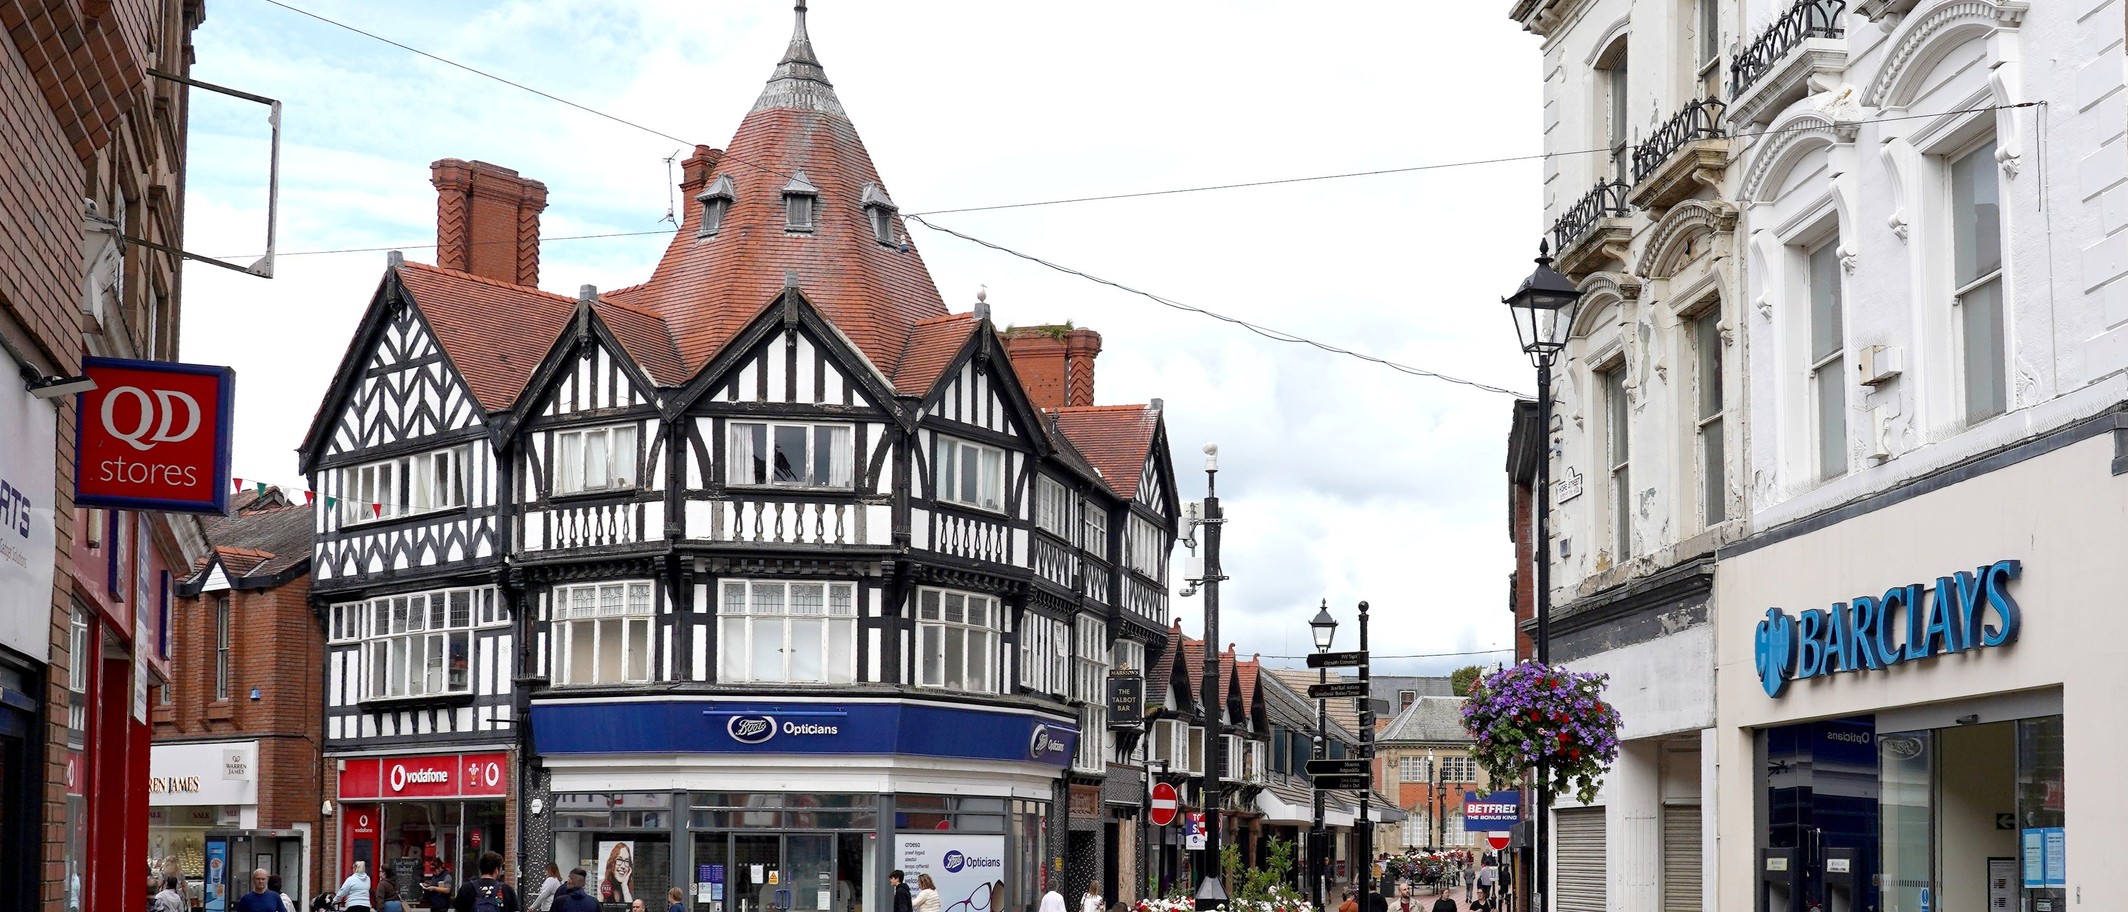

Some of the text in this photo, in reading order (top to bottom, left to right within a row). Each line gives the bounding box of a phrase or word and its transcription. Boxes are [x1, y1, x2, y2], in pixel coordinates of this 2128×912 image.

[101, 386, 201, 451] QD
[100, 455, 197, 487] stores
[1800, 560, 2022, 679] BARCLAYS
[735, 719, 838, 736] Boots Opticians
[1048, 739, 1065, 752] Opticians
[406, 768, 448, 783] vodafone
[168, 776, 199, 794] JAMES
[1467, 803, 1517, 814] BETFRED
[966, 857, 1001, 869] Opticians
